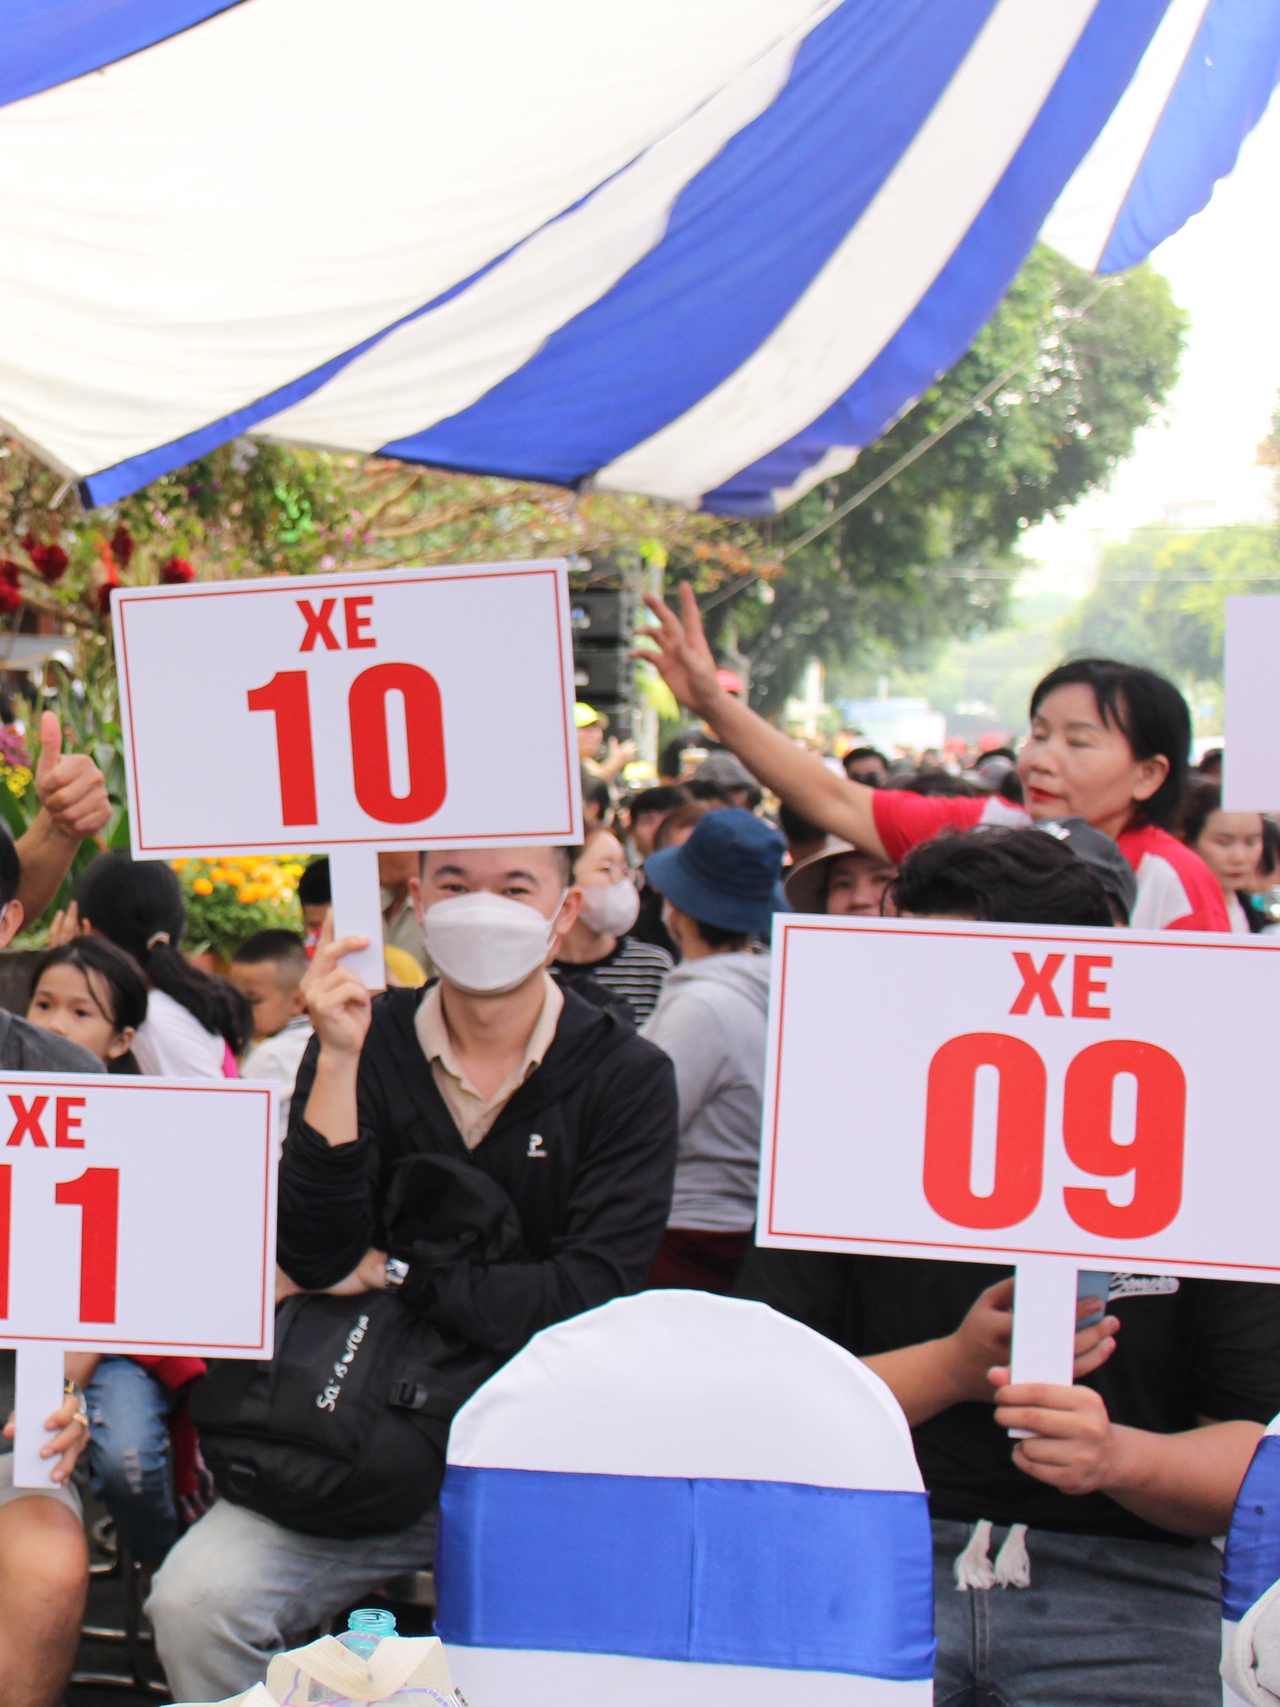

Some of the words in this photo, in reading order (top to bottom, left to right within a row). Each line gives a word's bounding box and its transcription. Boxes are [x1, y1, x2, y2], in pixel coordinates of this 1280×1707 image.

[296, 595, 377, 653] XE
[247, 662, 447, 826] 10
[1009, 952, 1112, 1019] XE
[7, 1094, 86, 1148] XE
[922, 1031, 1187, 1240] 09
